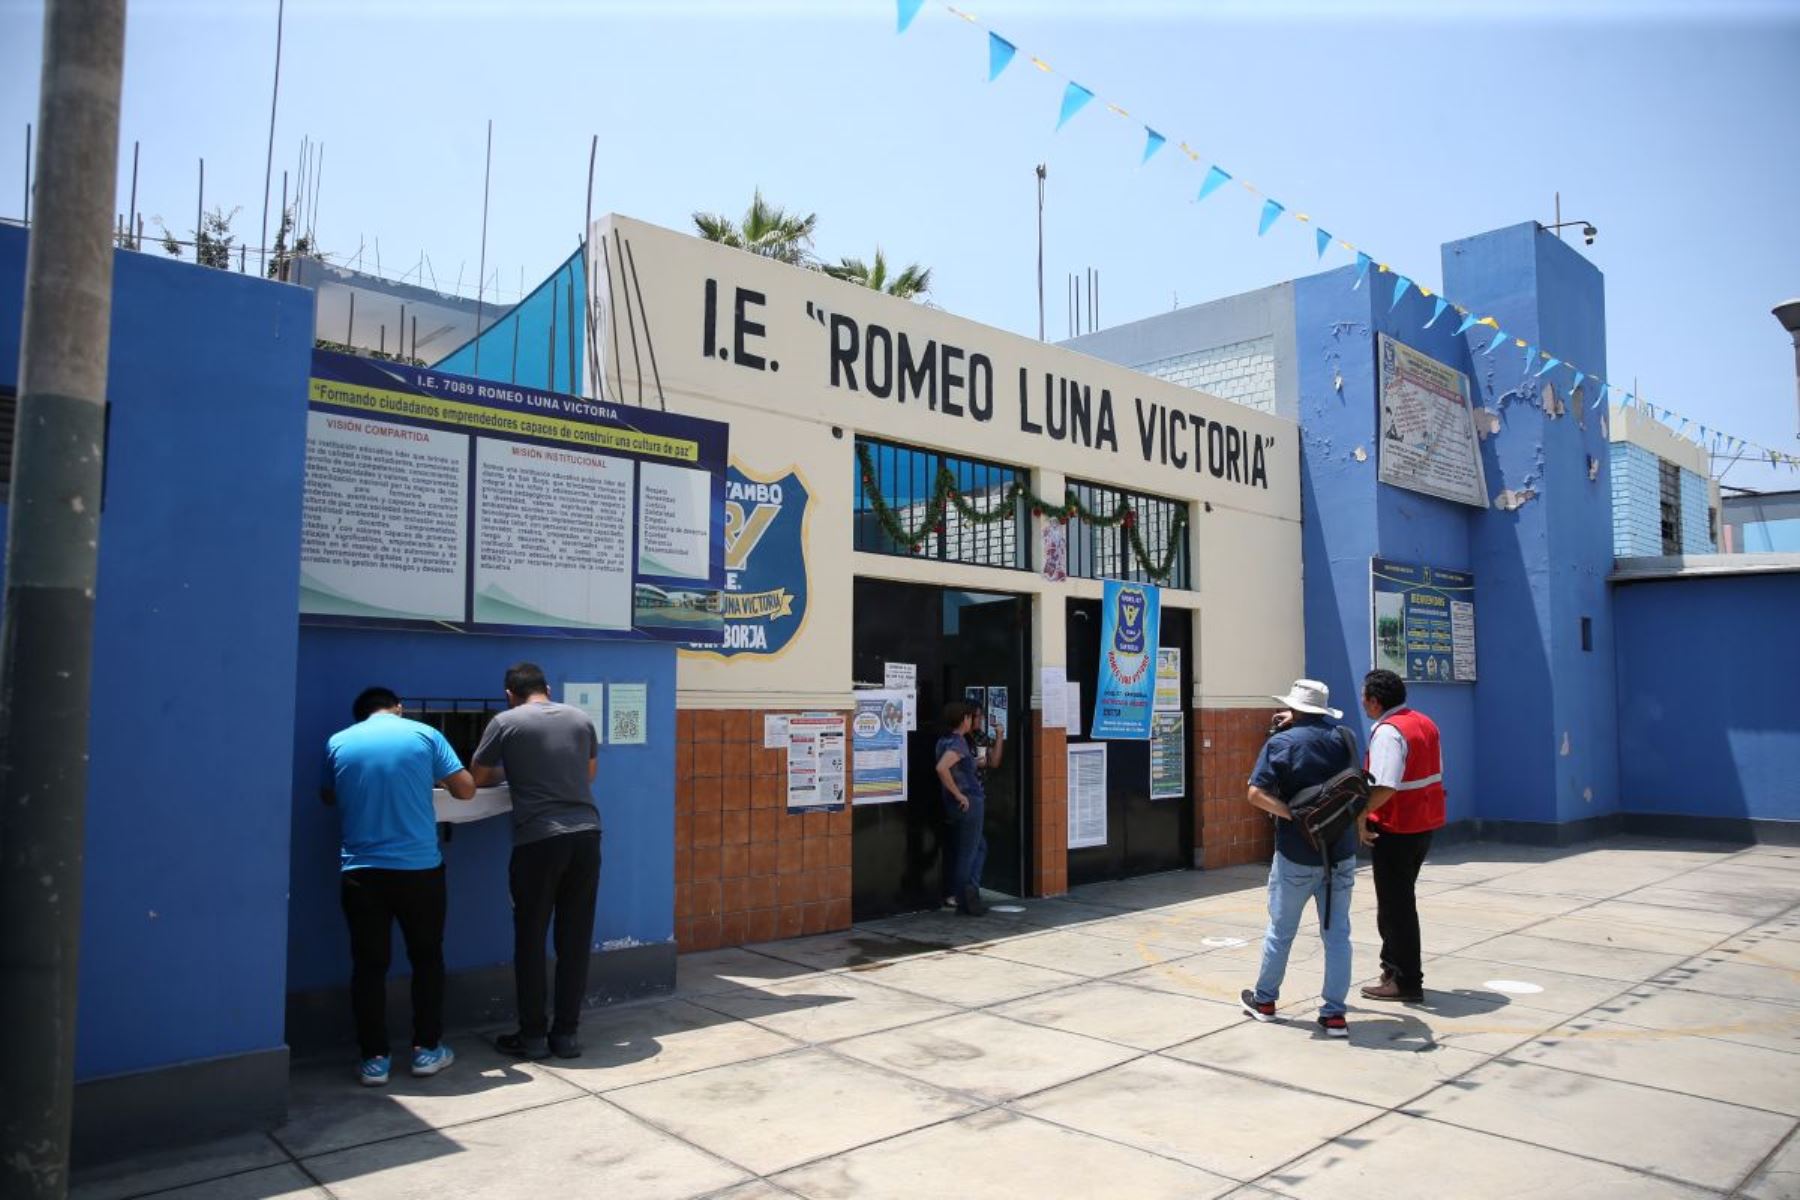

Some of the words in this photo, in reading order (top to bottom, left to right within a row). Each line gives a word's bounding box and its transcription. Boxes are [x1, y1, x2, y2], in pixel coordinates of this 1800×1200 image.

[703, 278, 780, 372] I.E.
[1019, 366, 1119, 453] LUNA
[418, 375, 439, 390] I.E.
[443, 380, 474, 395] 7089
[478, 386, 523, 403] ROMEO
[527, 394, 559, 410] LUNA
[563, 401, 618, 419] VICTORIA
[365, 424, 430, 442] COMPARTIDA
[380, 397, 440, 417] ciudadanos
[442, 408, 518, 430] emprendedores
[521, 420, 558, 437] capaces
[560, 424, 572, 437] de
[574, 428, 614, 445] construir
[615, 435, 631, 447] una
[632, 436, 661, 452] cultura
[664, 441, 673, 453] de
[544, 451, 607, 469] INSTITUCIONAL
[722, 624, 767, 649] BORJA
